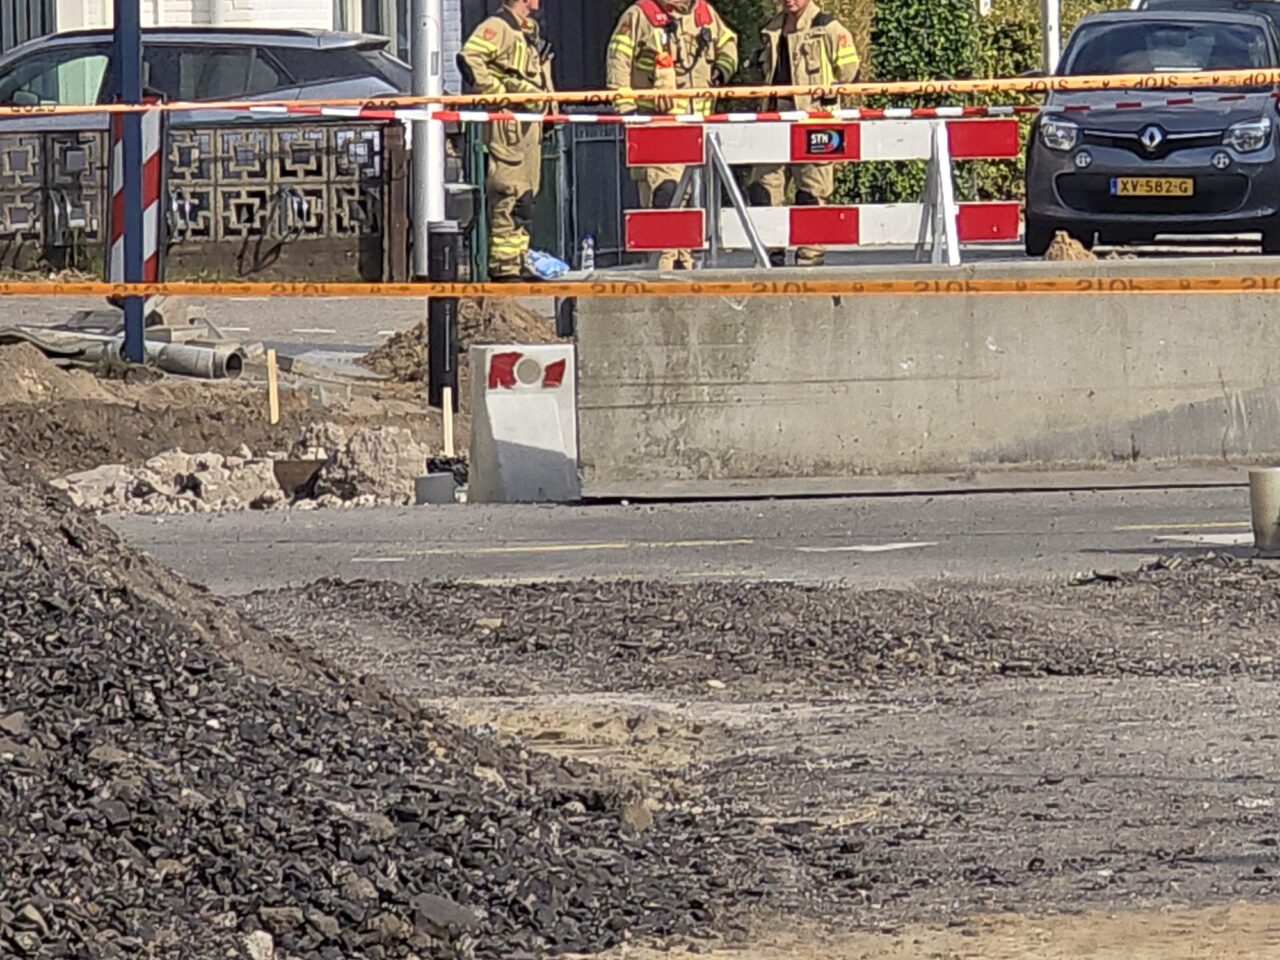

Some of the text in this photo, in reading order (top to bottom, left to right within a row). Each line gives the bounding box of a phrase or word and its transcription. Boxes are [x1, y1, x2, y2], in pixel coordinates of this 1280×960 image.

[1134, 75, 1178, 88] STOP
[810, 133, 829, 144] STN
[1121, 179, 1188, 194] XV-582-G
